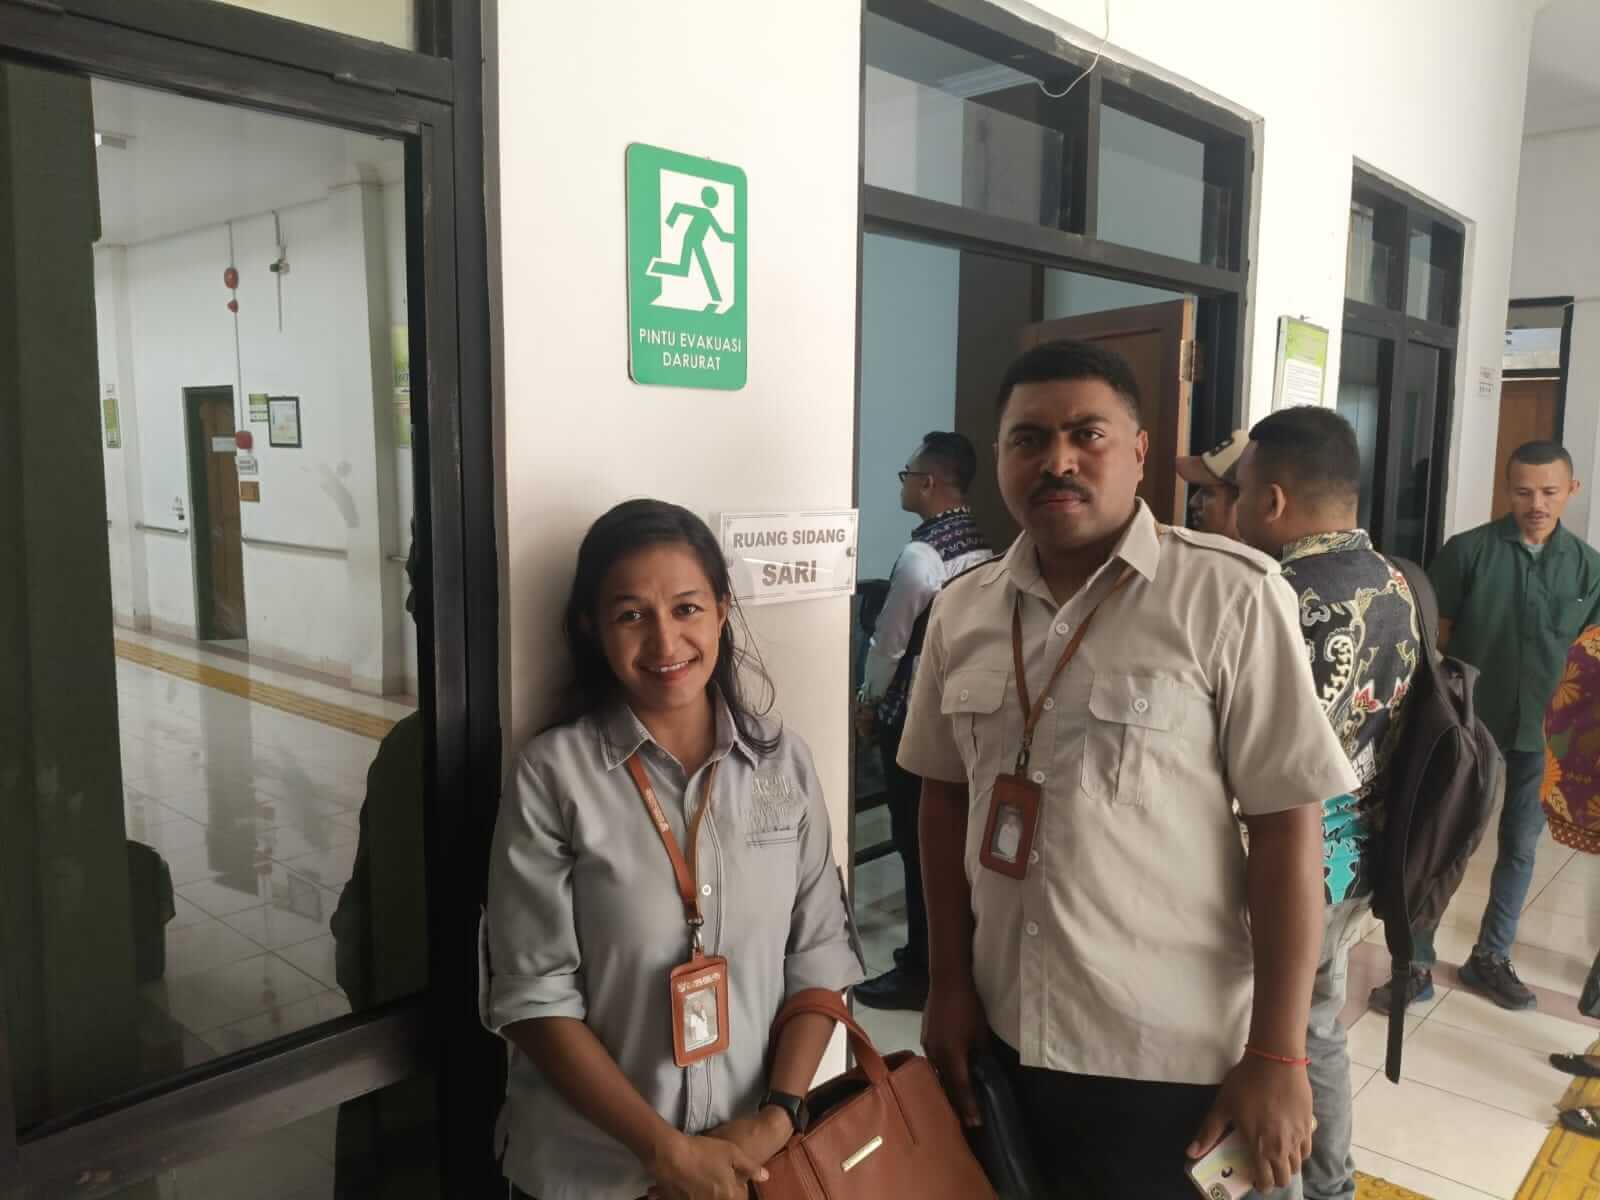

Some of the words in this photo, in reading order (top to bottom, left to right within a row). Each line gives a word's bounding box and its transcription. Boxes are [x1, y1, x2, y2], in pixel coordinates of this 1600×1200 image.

[639, 328, 676, 346] PINTU
[680, 333, 741, 352] EVAKUASI
[663, 352, 720, 370] DARURAT
[733, 531, 787, 548] RUANG
[792, 529, 845, 545] SIDANG
[761, 560, 817, 586] SARI
